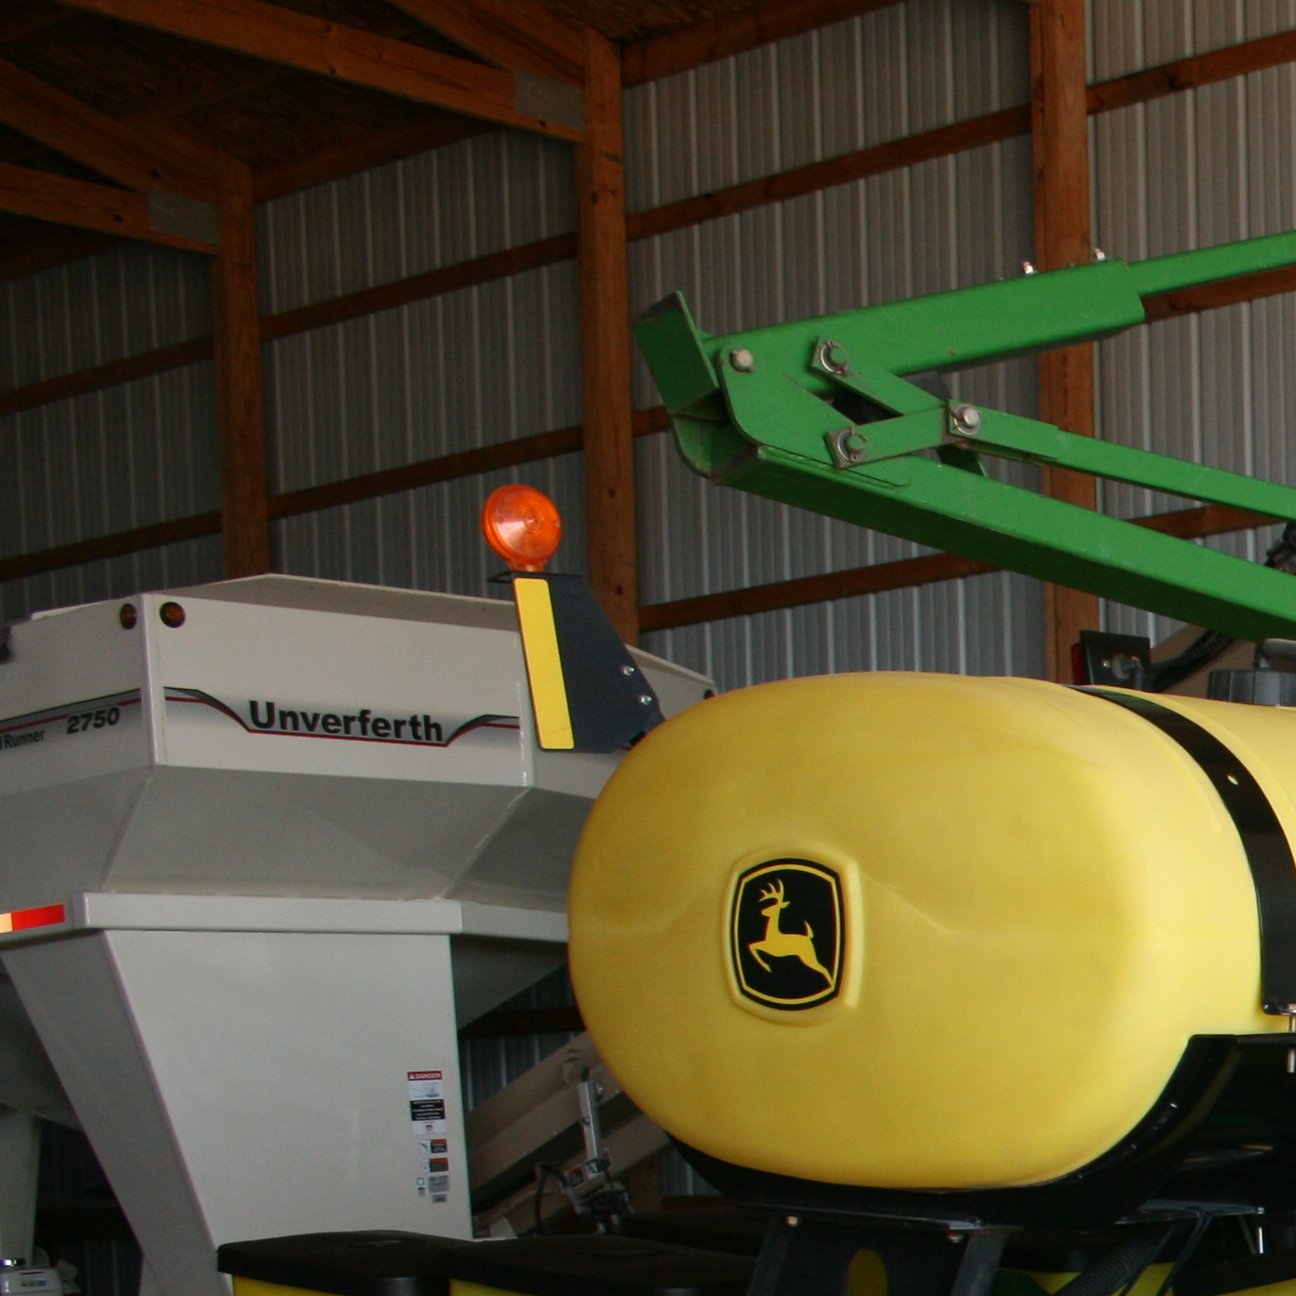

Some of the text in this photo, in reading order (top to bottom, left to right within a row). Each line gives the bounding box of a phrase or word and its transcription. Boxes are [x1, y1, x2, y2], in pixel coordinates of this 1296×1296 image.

[4, 729, 46, 750] Runner
[66, 706, 120, 735] 2750
[249, 699, 443, 742] Unverferth
